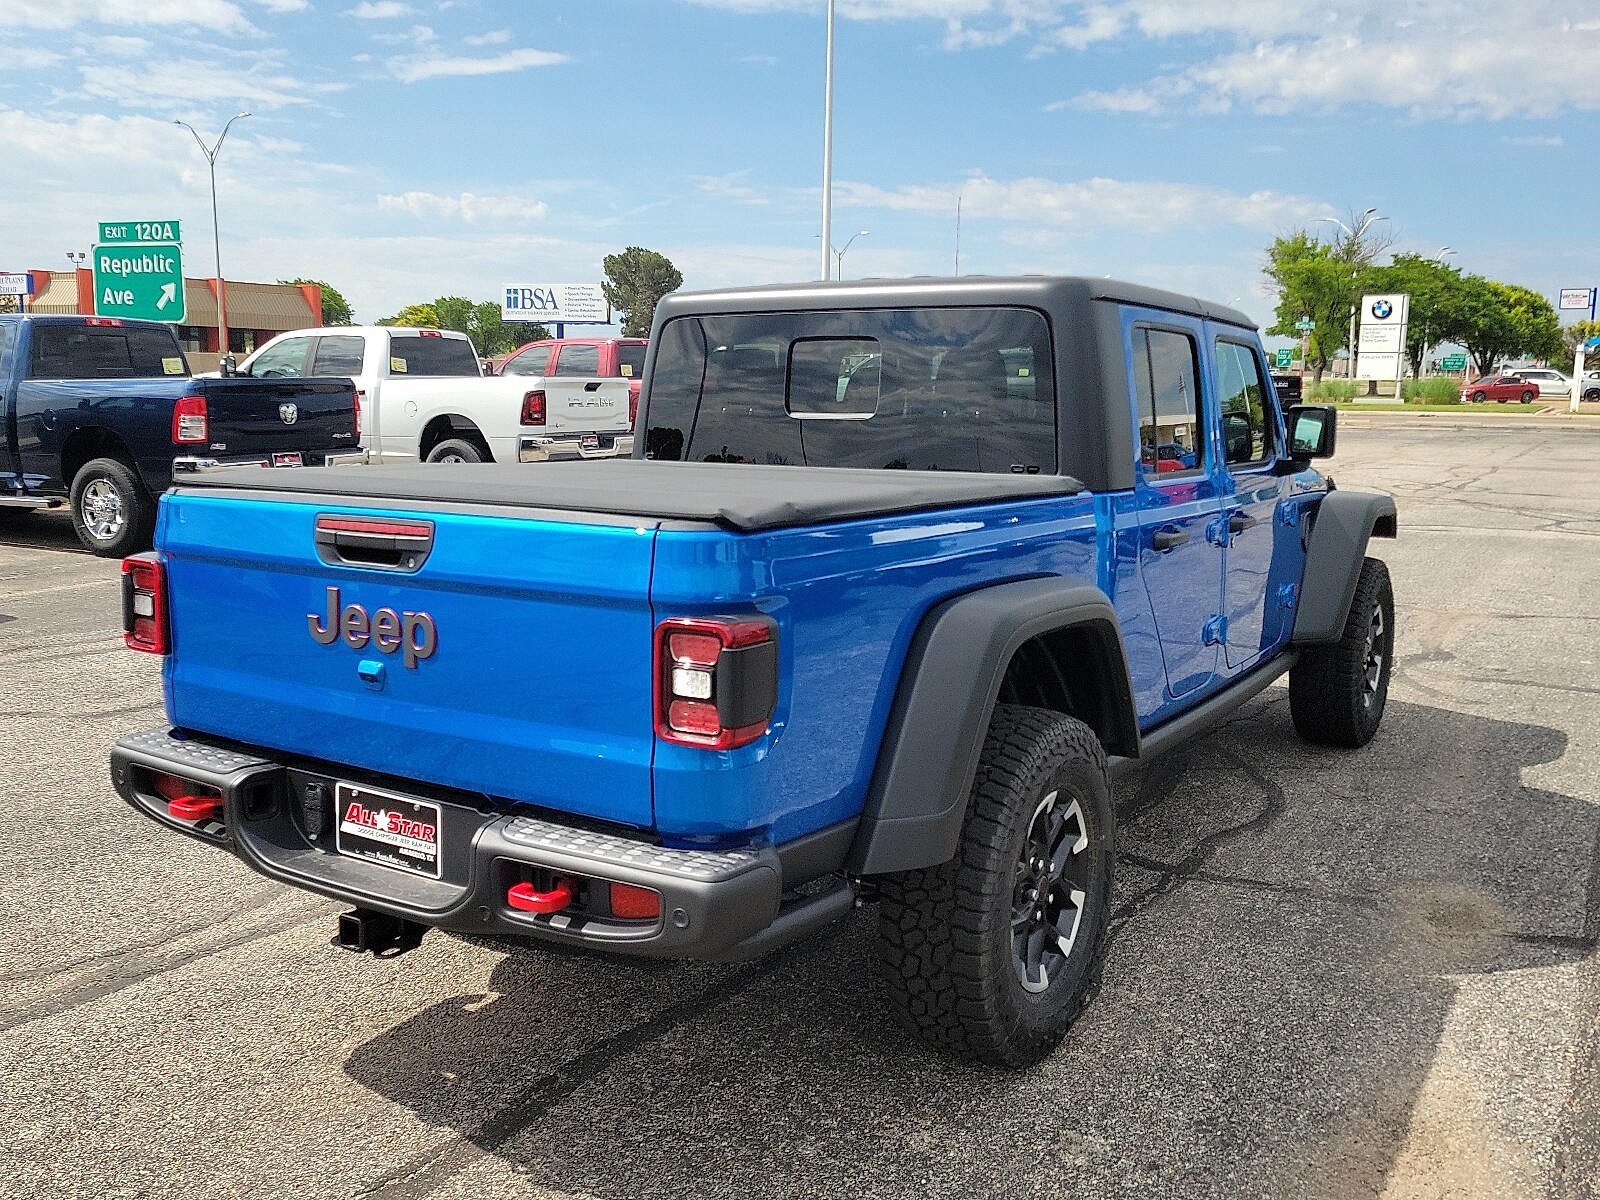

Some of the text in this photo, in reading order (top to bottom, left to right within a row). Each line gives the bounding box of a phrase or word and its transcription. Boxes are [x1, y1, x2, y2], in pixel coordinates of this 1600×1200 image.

[105, 223, 174, 240] EXIT 120A
[100, 254, 175, 278] Republic
[103, 287, 135, 305] Ave
[306, 585, 438, 669] Jeep
